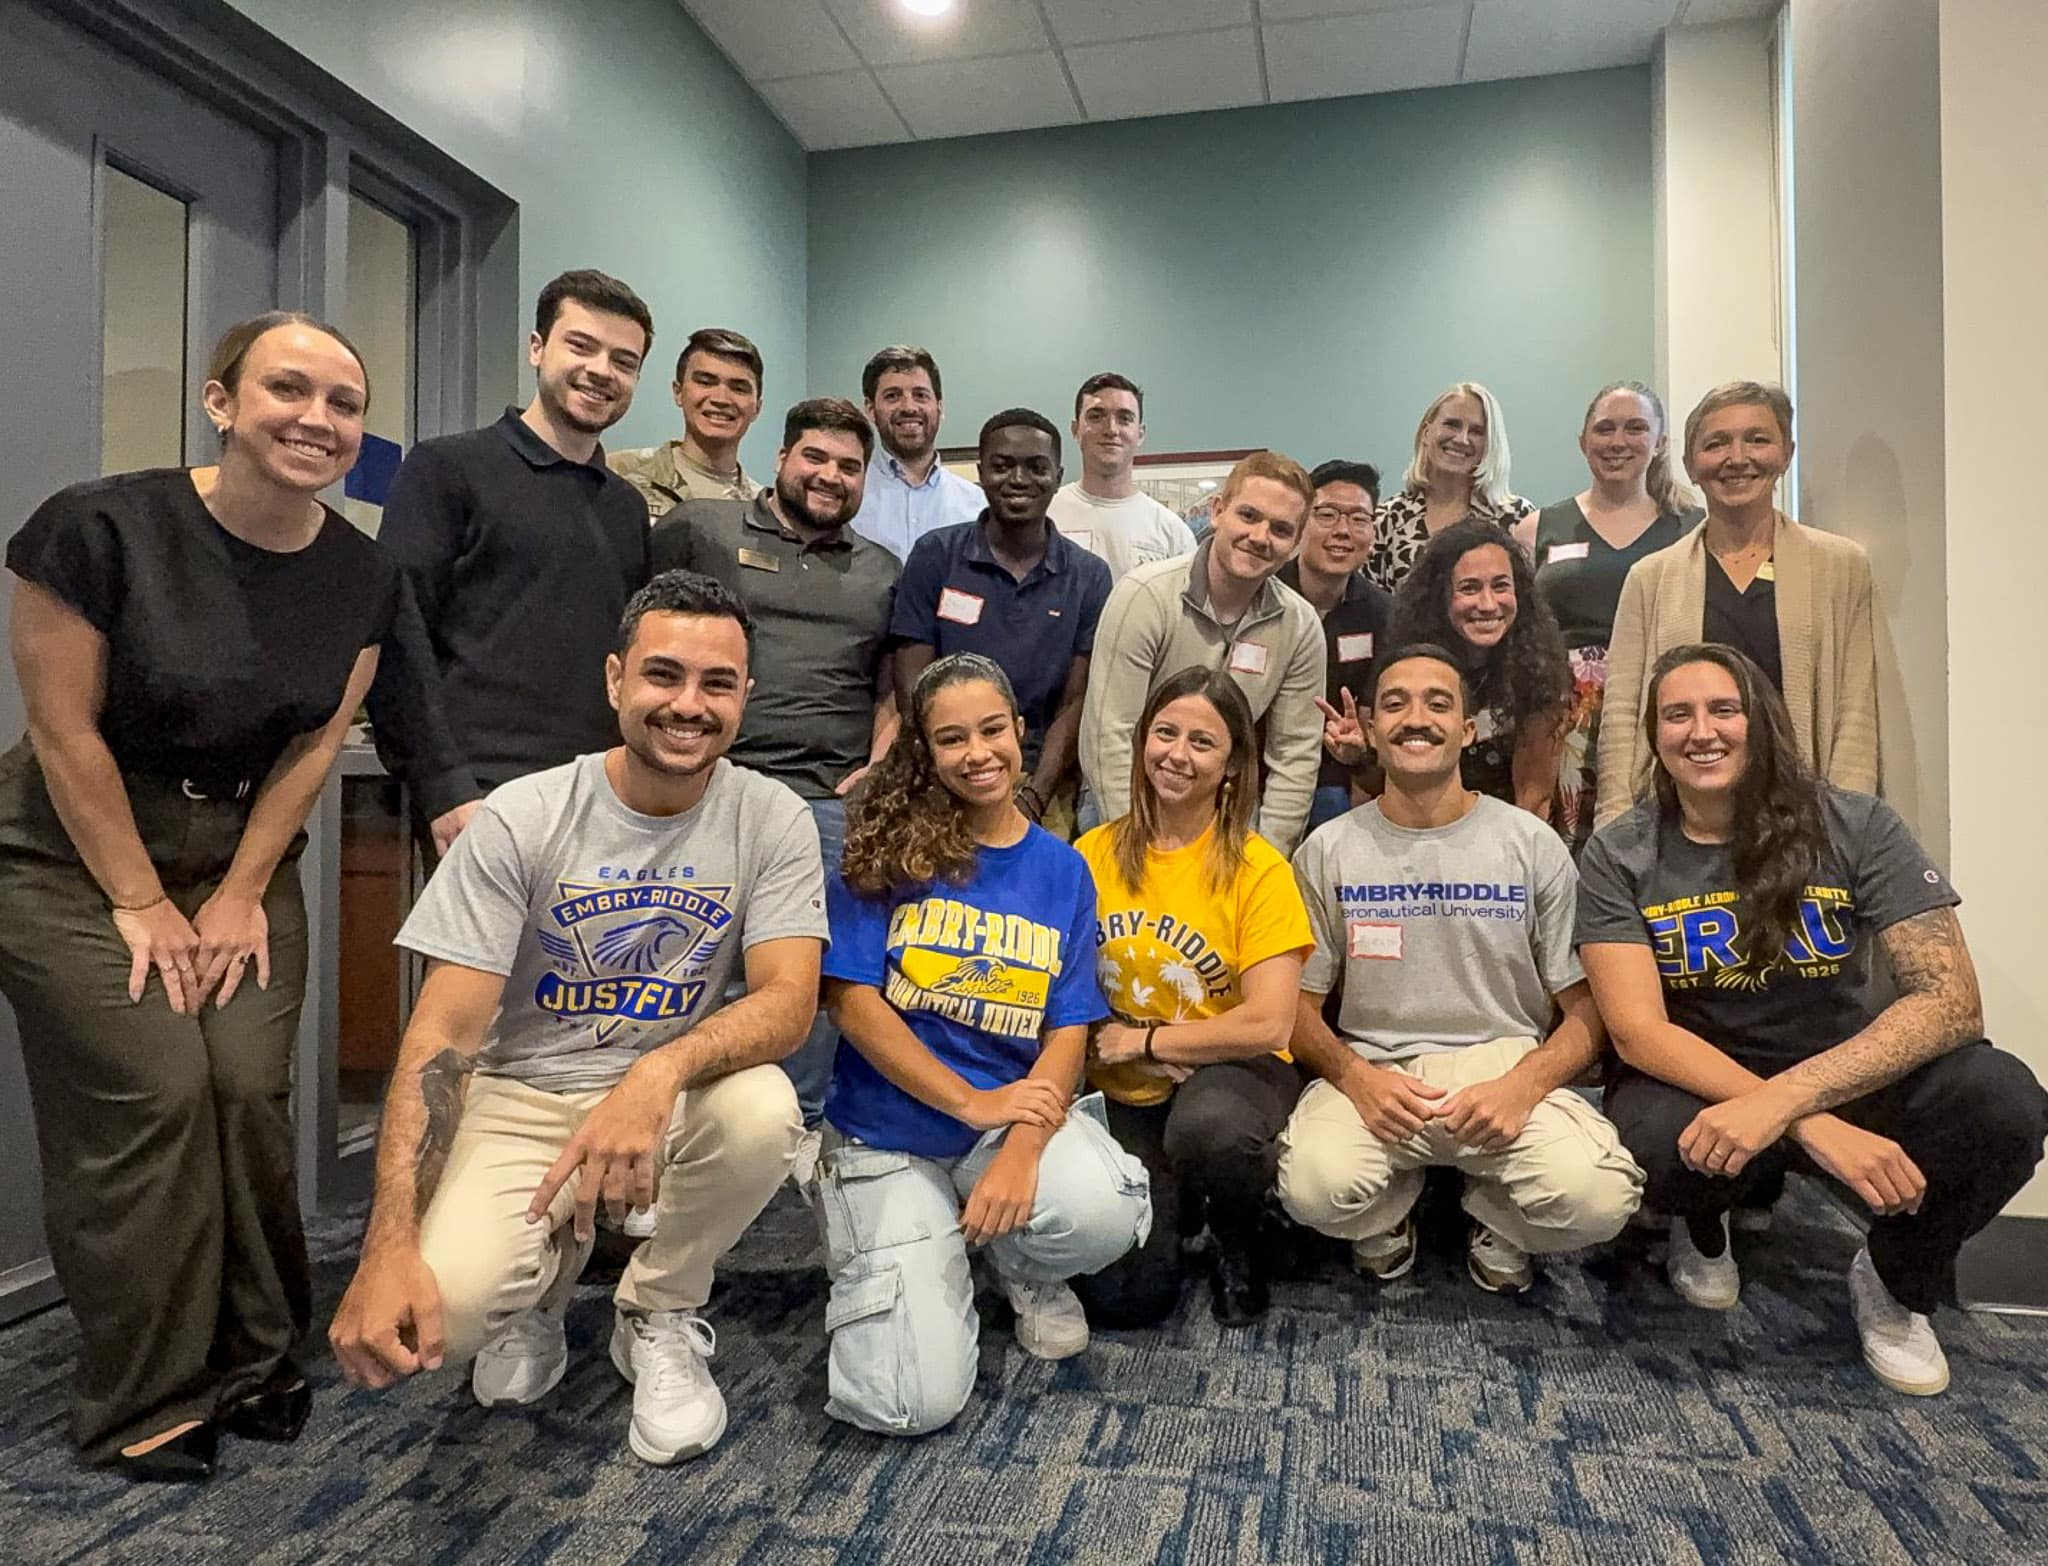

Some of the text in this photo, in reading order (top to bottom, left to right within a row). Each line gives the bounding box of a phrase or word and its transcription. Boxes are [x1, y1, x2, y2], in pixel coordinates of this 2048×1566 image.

[598, 866, 695, 881] EAGLES
[1335, 883, 1525, 902] EMBRY-RIDDLE
[561, 889, 726, 924] EMBRY-RIDDLE
[1442, 903, 1526, 921] University
[1799, 964, 1841, 979] 1926
[1015, 990, 1041, 1005] 1926
